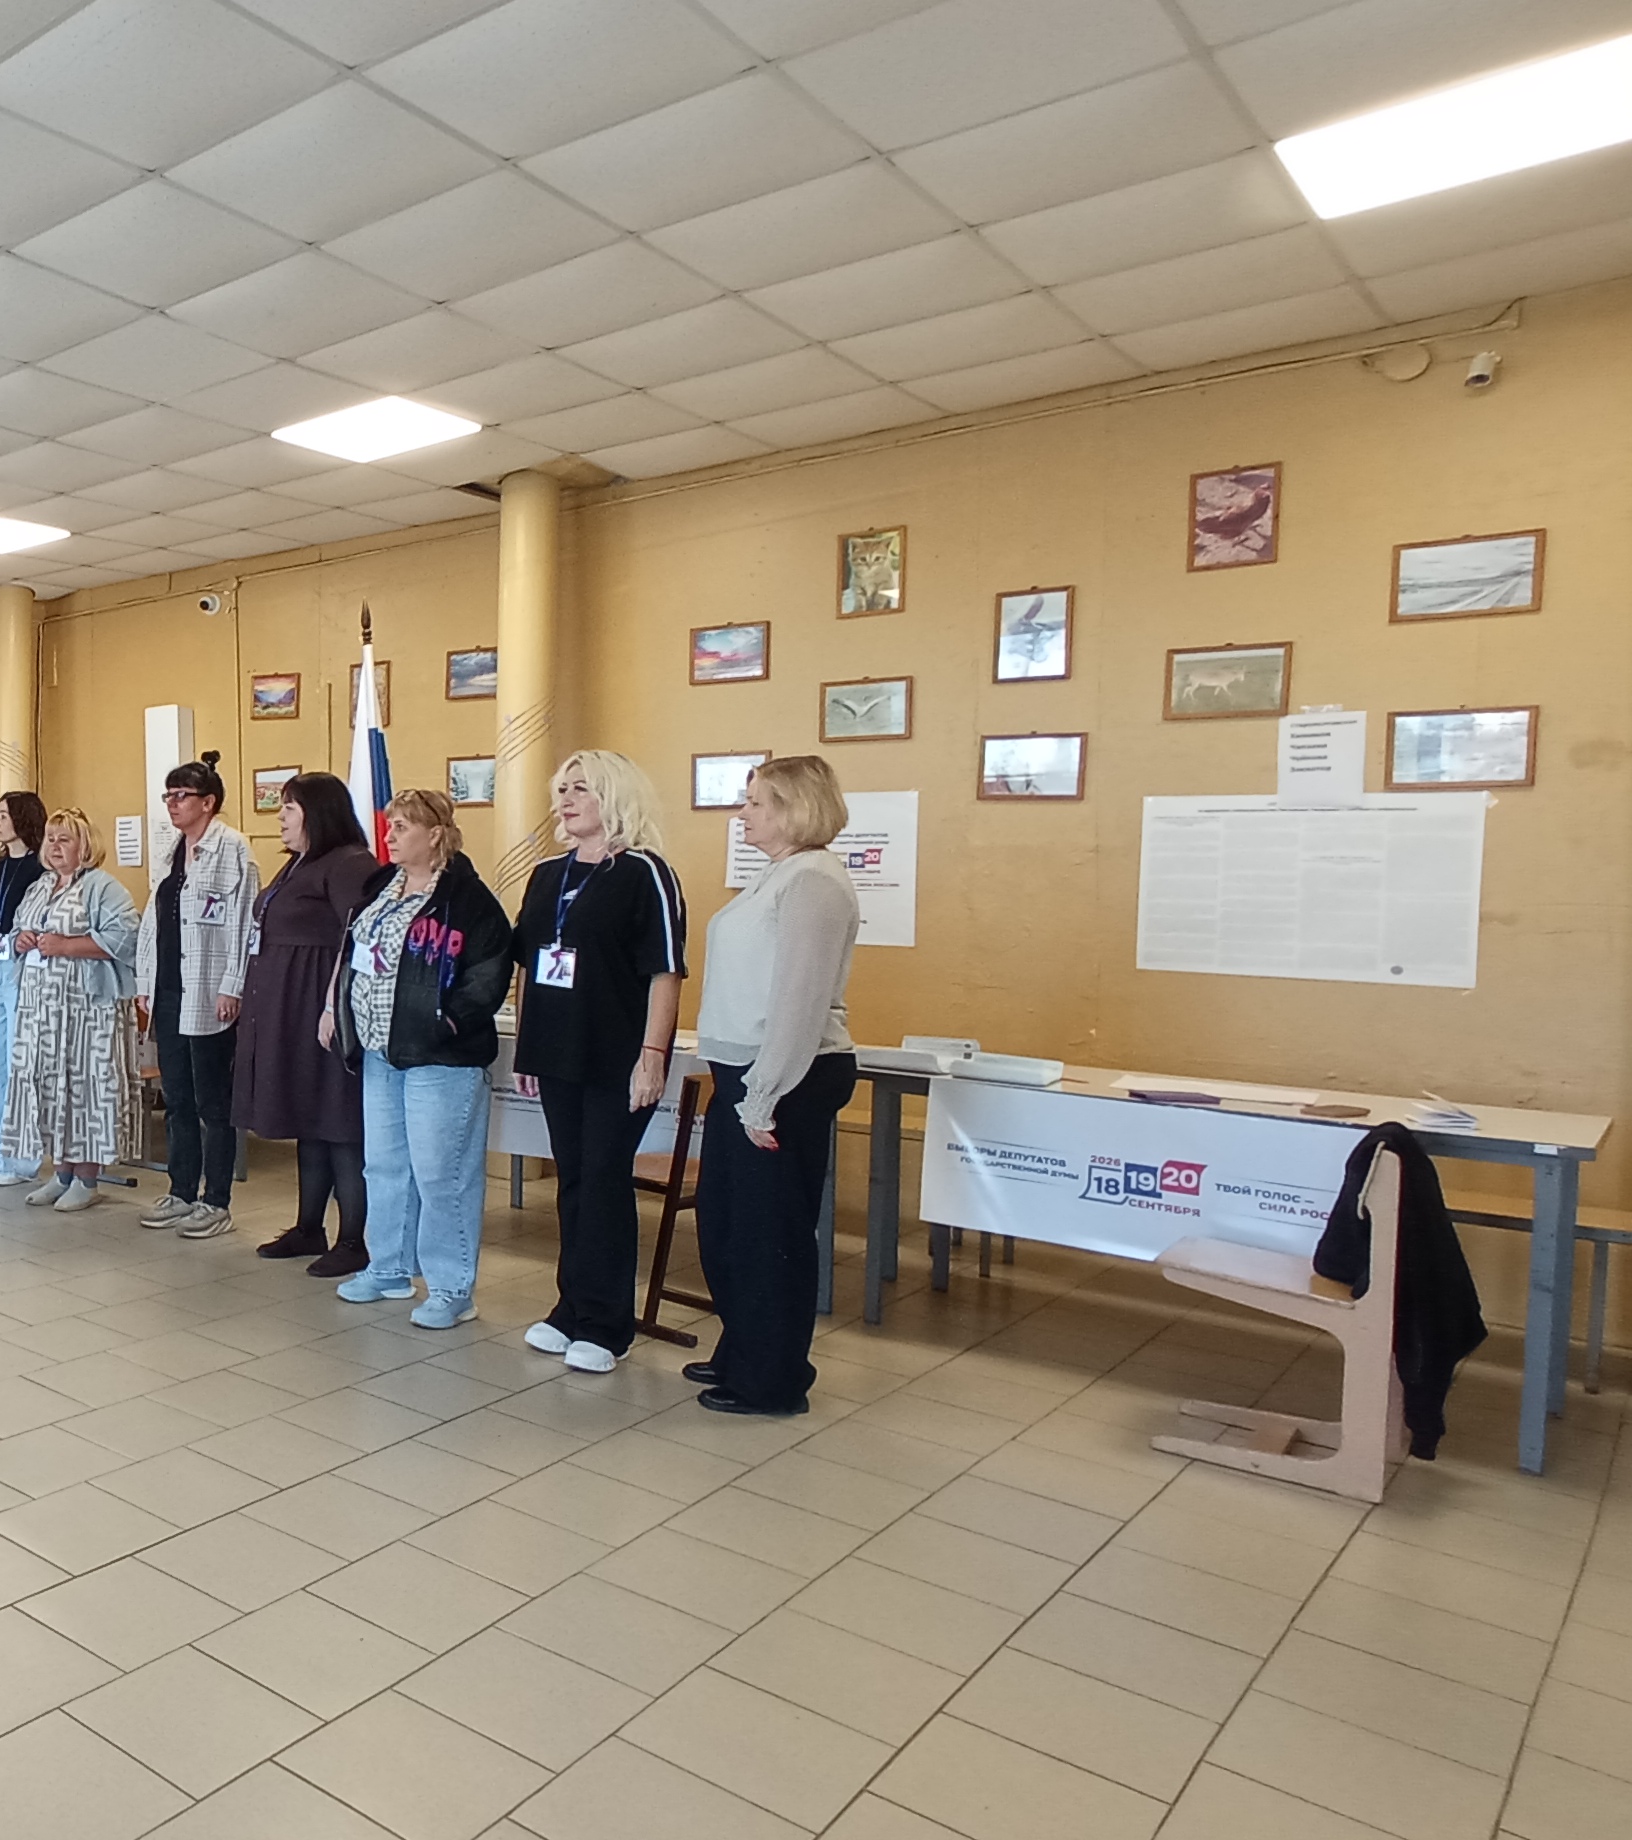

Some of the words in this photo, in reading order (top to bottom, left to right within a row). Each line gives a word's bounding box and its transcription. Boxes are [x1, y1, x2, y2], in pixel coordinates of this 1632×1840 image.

[864, 851, 880, 862] 20
[960, 1156, 1049, 1176] ГОДАРСТВЕННОЙ
[998, 1149, 1067, 1168] ДЕПУТАТОВ
[1090, 1155, 1121, 1167] 2026
[1093, 1176, 1120, 1196] 18
[1126, 1170, 1156, 1192] 19
[1161, 1166, 1199, 1189] 20
[1215, 1183, 1252, 1196] ТВОЙ
[1254, 1188, 1301, 1204] ГОЛОС
[1128, 1198, 1201, 1218] СЕНТЯБРЯ
[1258, 1201, 1297, 1215] СИЛА
[1300, 1207, 1331, 1221] РОС
